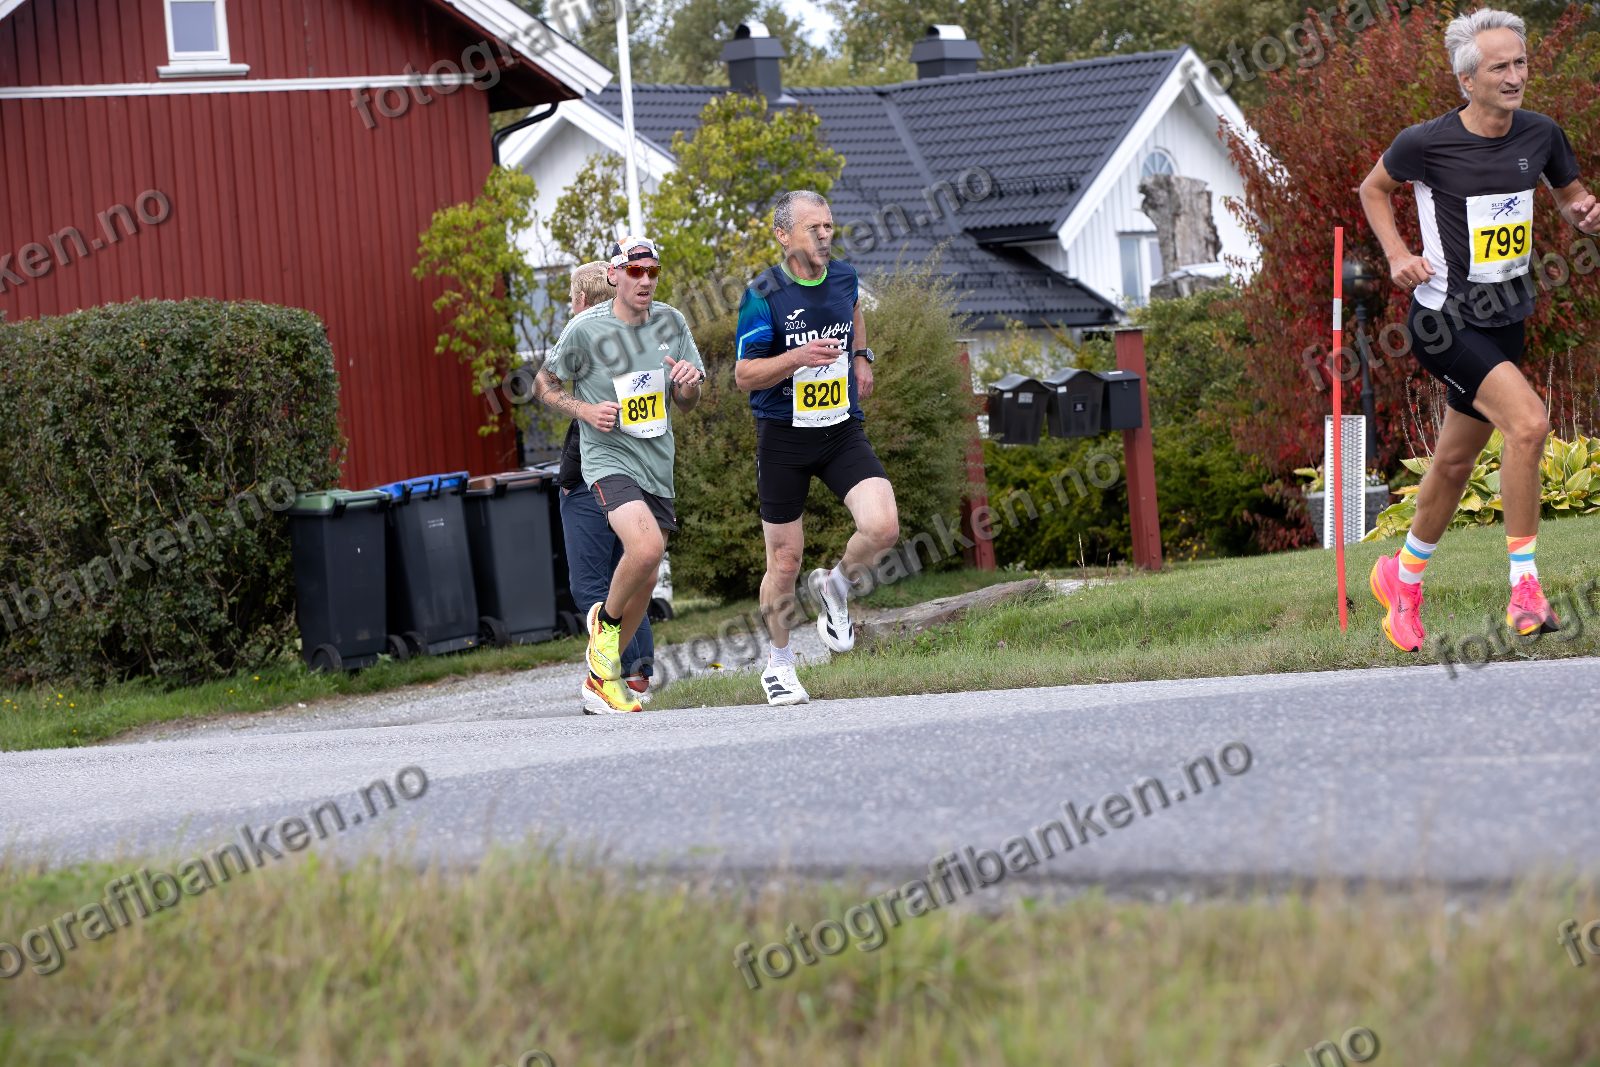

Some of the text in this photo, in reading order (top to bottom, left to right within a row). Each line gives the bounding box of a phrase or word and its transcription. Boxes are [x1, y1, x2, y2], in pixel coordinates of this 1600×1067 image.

[1481, 225, 1525, 258] 799
[785, 320, 807, 330] 2026
[785, 330, 819, 346] run
[803, 381, 840, 407] 820
[628, 395, 656, 421] 897
